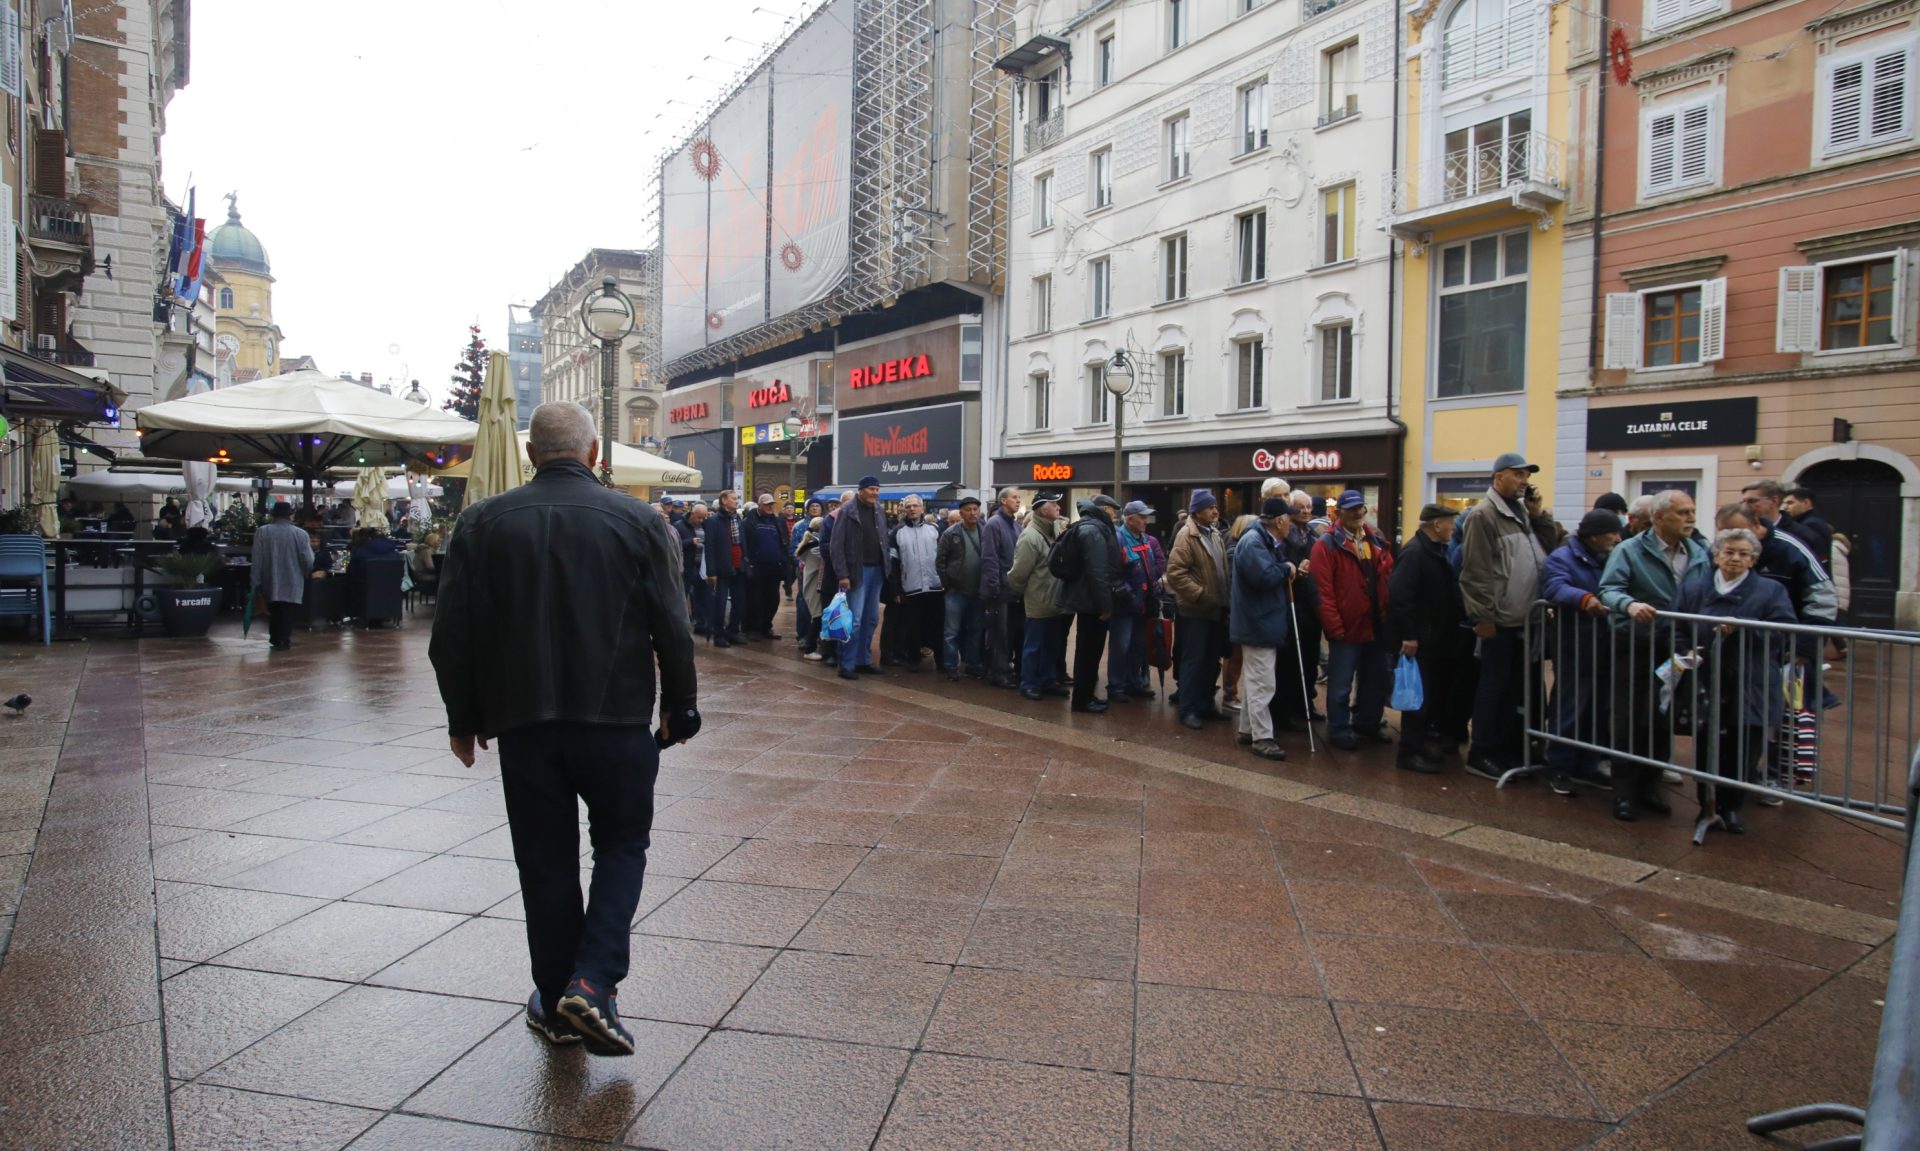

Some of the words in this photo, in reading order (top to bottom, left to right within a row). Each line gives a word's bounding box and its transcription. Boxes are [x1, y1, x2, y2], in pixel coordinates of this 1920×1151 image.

[851, 354, 932, 389] RIJEKA
[749, 379, 790, 408] KUĆA
[670, 402, 708, 424] ROBNA
[1626, 423, 1677, 434] ZLATARNA
[1678, 420, 1708, 431] CELJE
[897, 460, 909, 475] for
[910, 460, 921, 471] the
[1276, 453, 1340, 471] ciciban
[1033, 463, 1072, 480] Rodea
